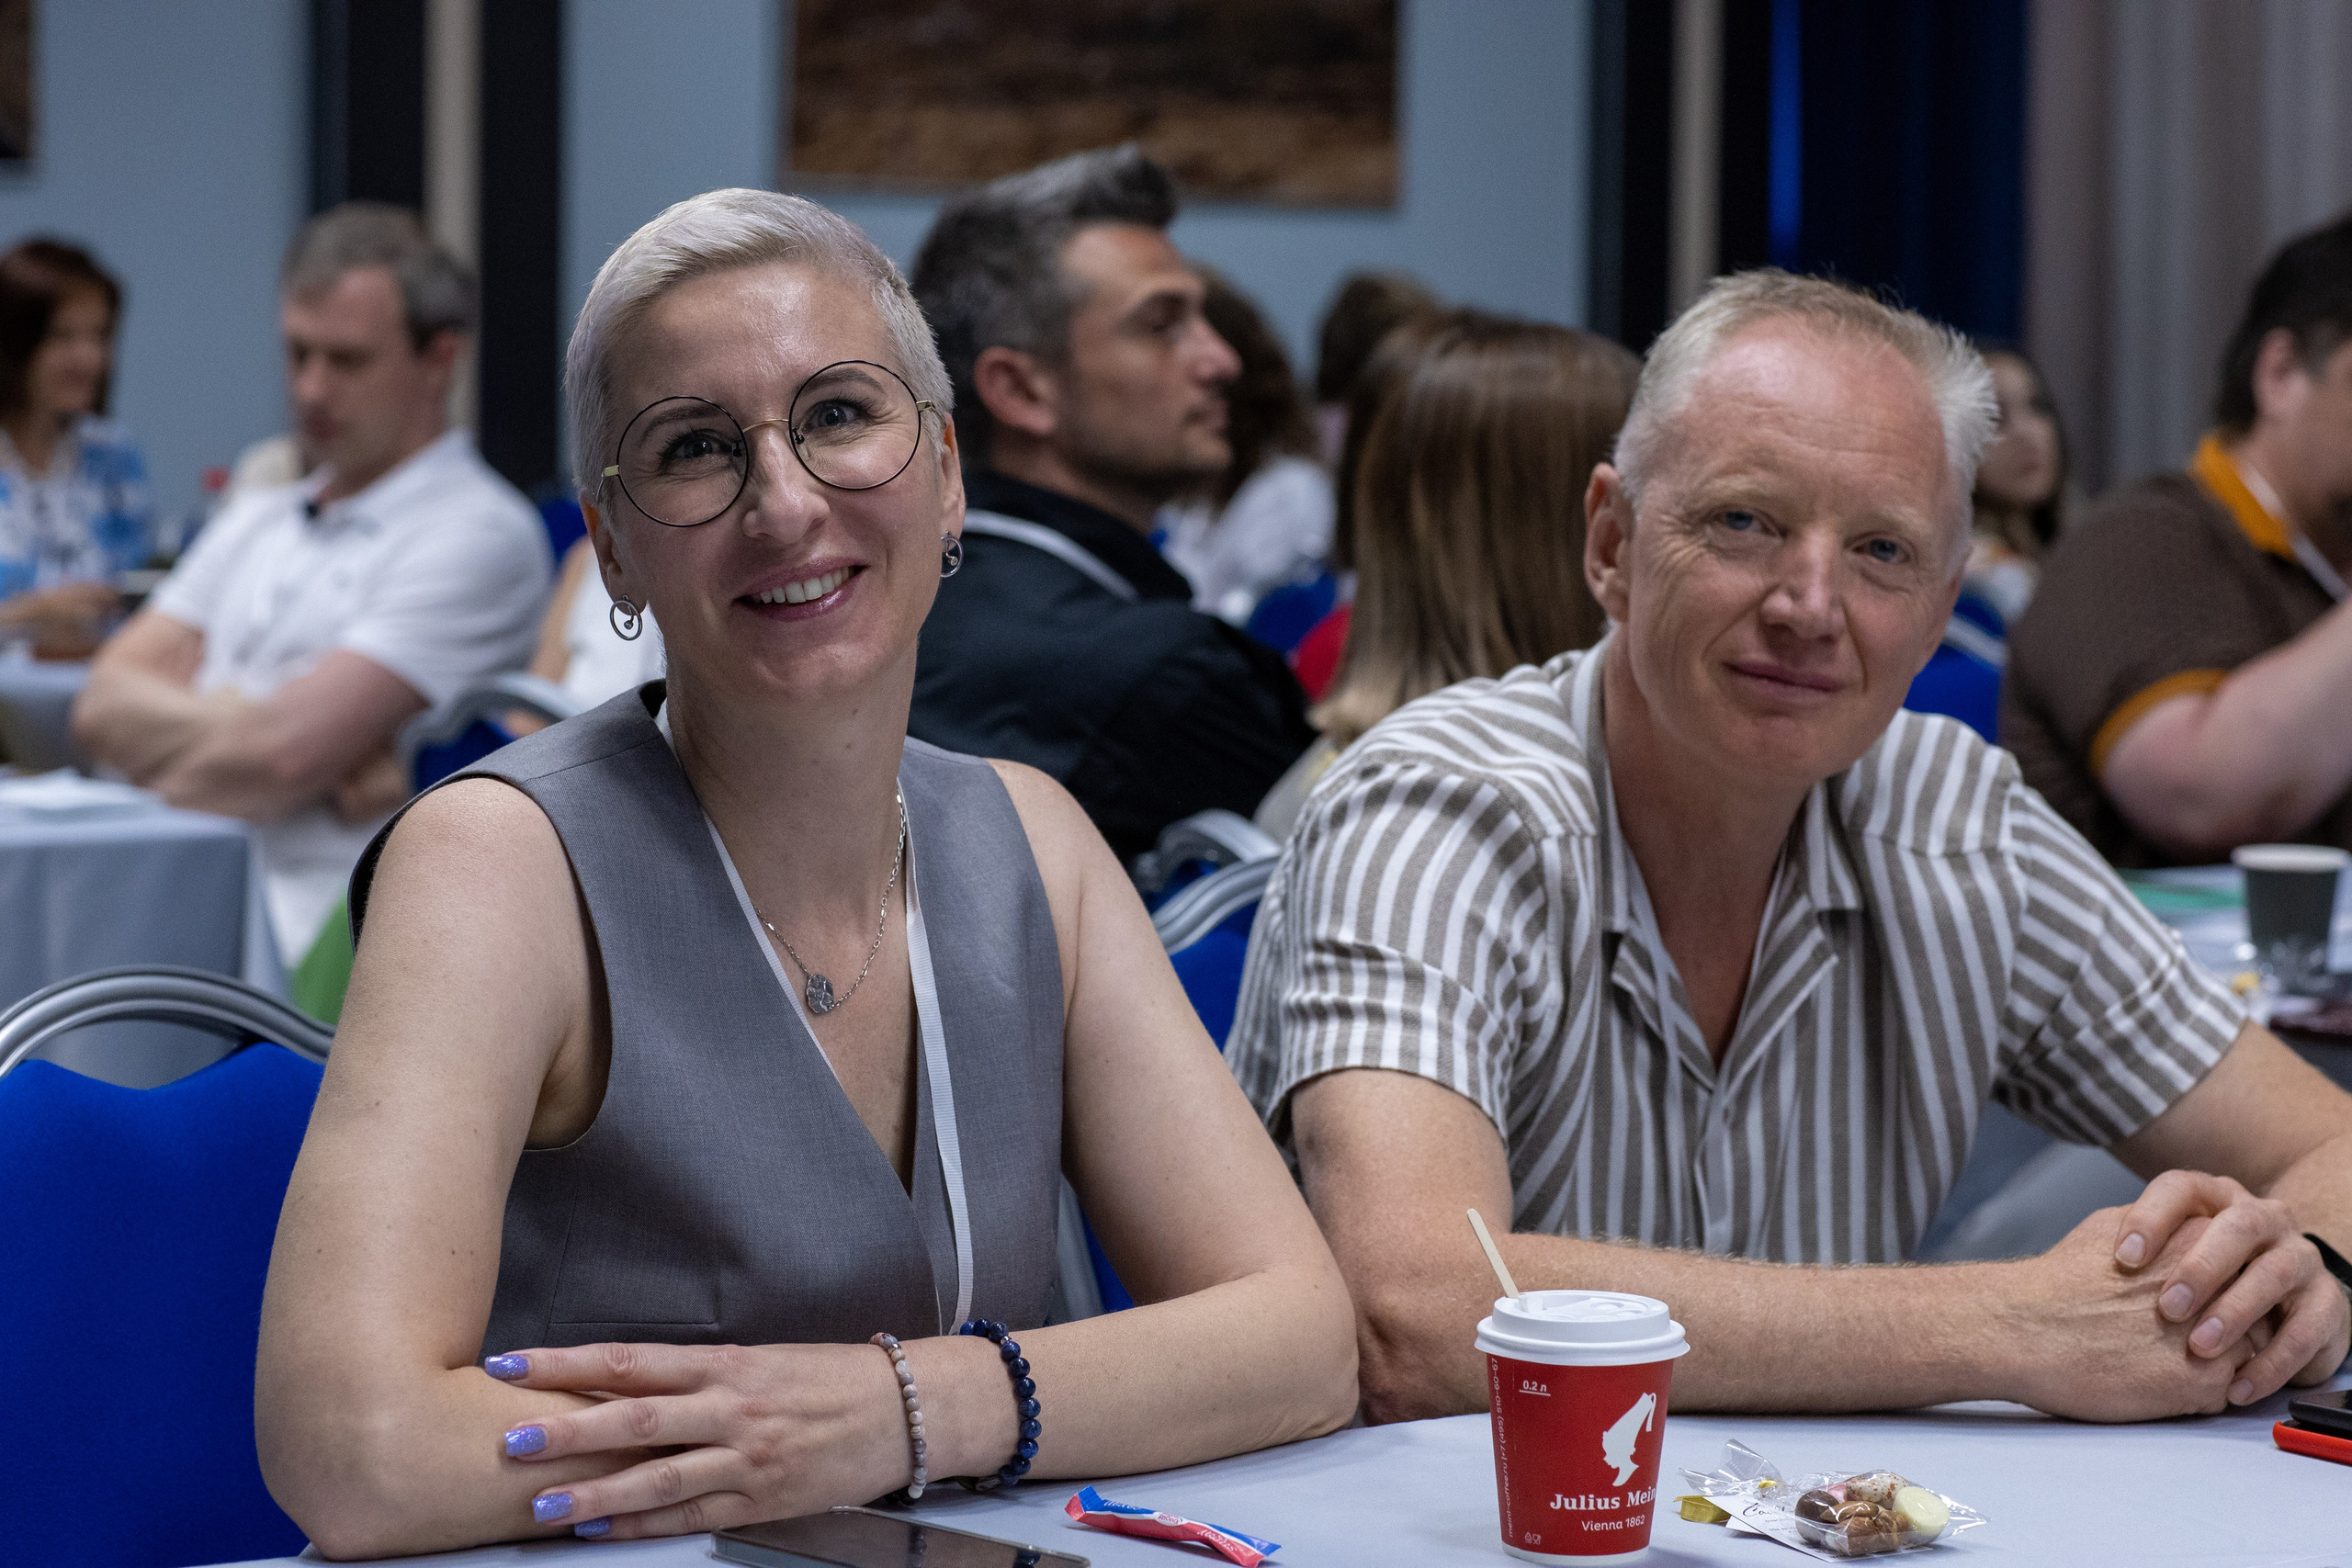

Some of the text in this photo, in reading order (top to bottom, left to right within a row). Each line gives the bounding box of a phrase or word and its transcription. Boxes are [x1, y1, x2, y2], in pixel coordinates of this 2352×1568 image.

[1491, 1358, 1503, 1414] 510-60-67
[1522, 1380, 1538, 1391] 0.2
[1498, 1416, 1507, 1444] (495)
[1549, 1494, 1621, 1510] Julius
[1581, 1515, 1645, 1531] Vienna 1862
